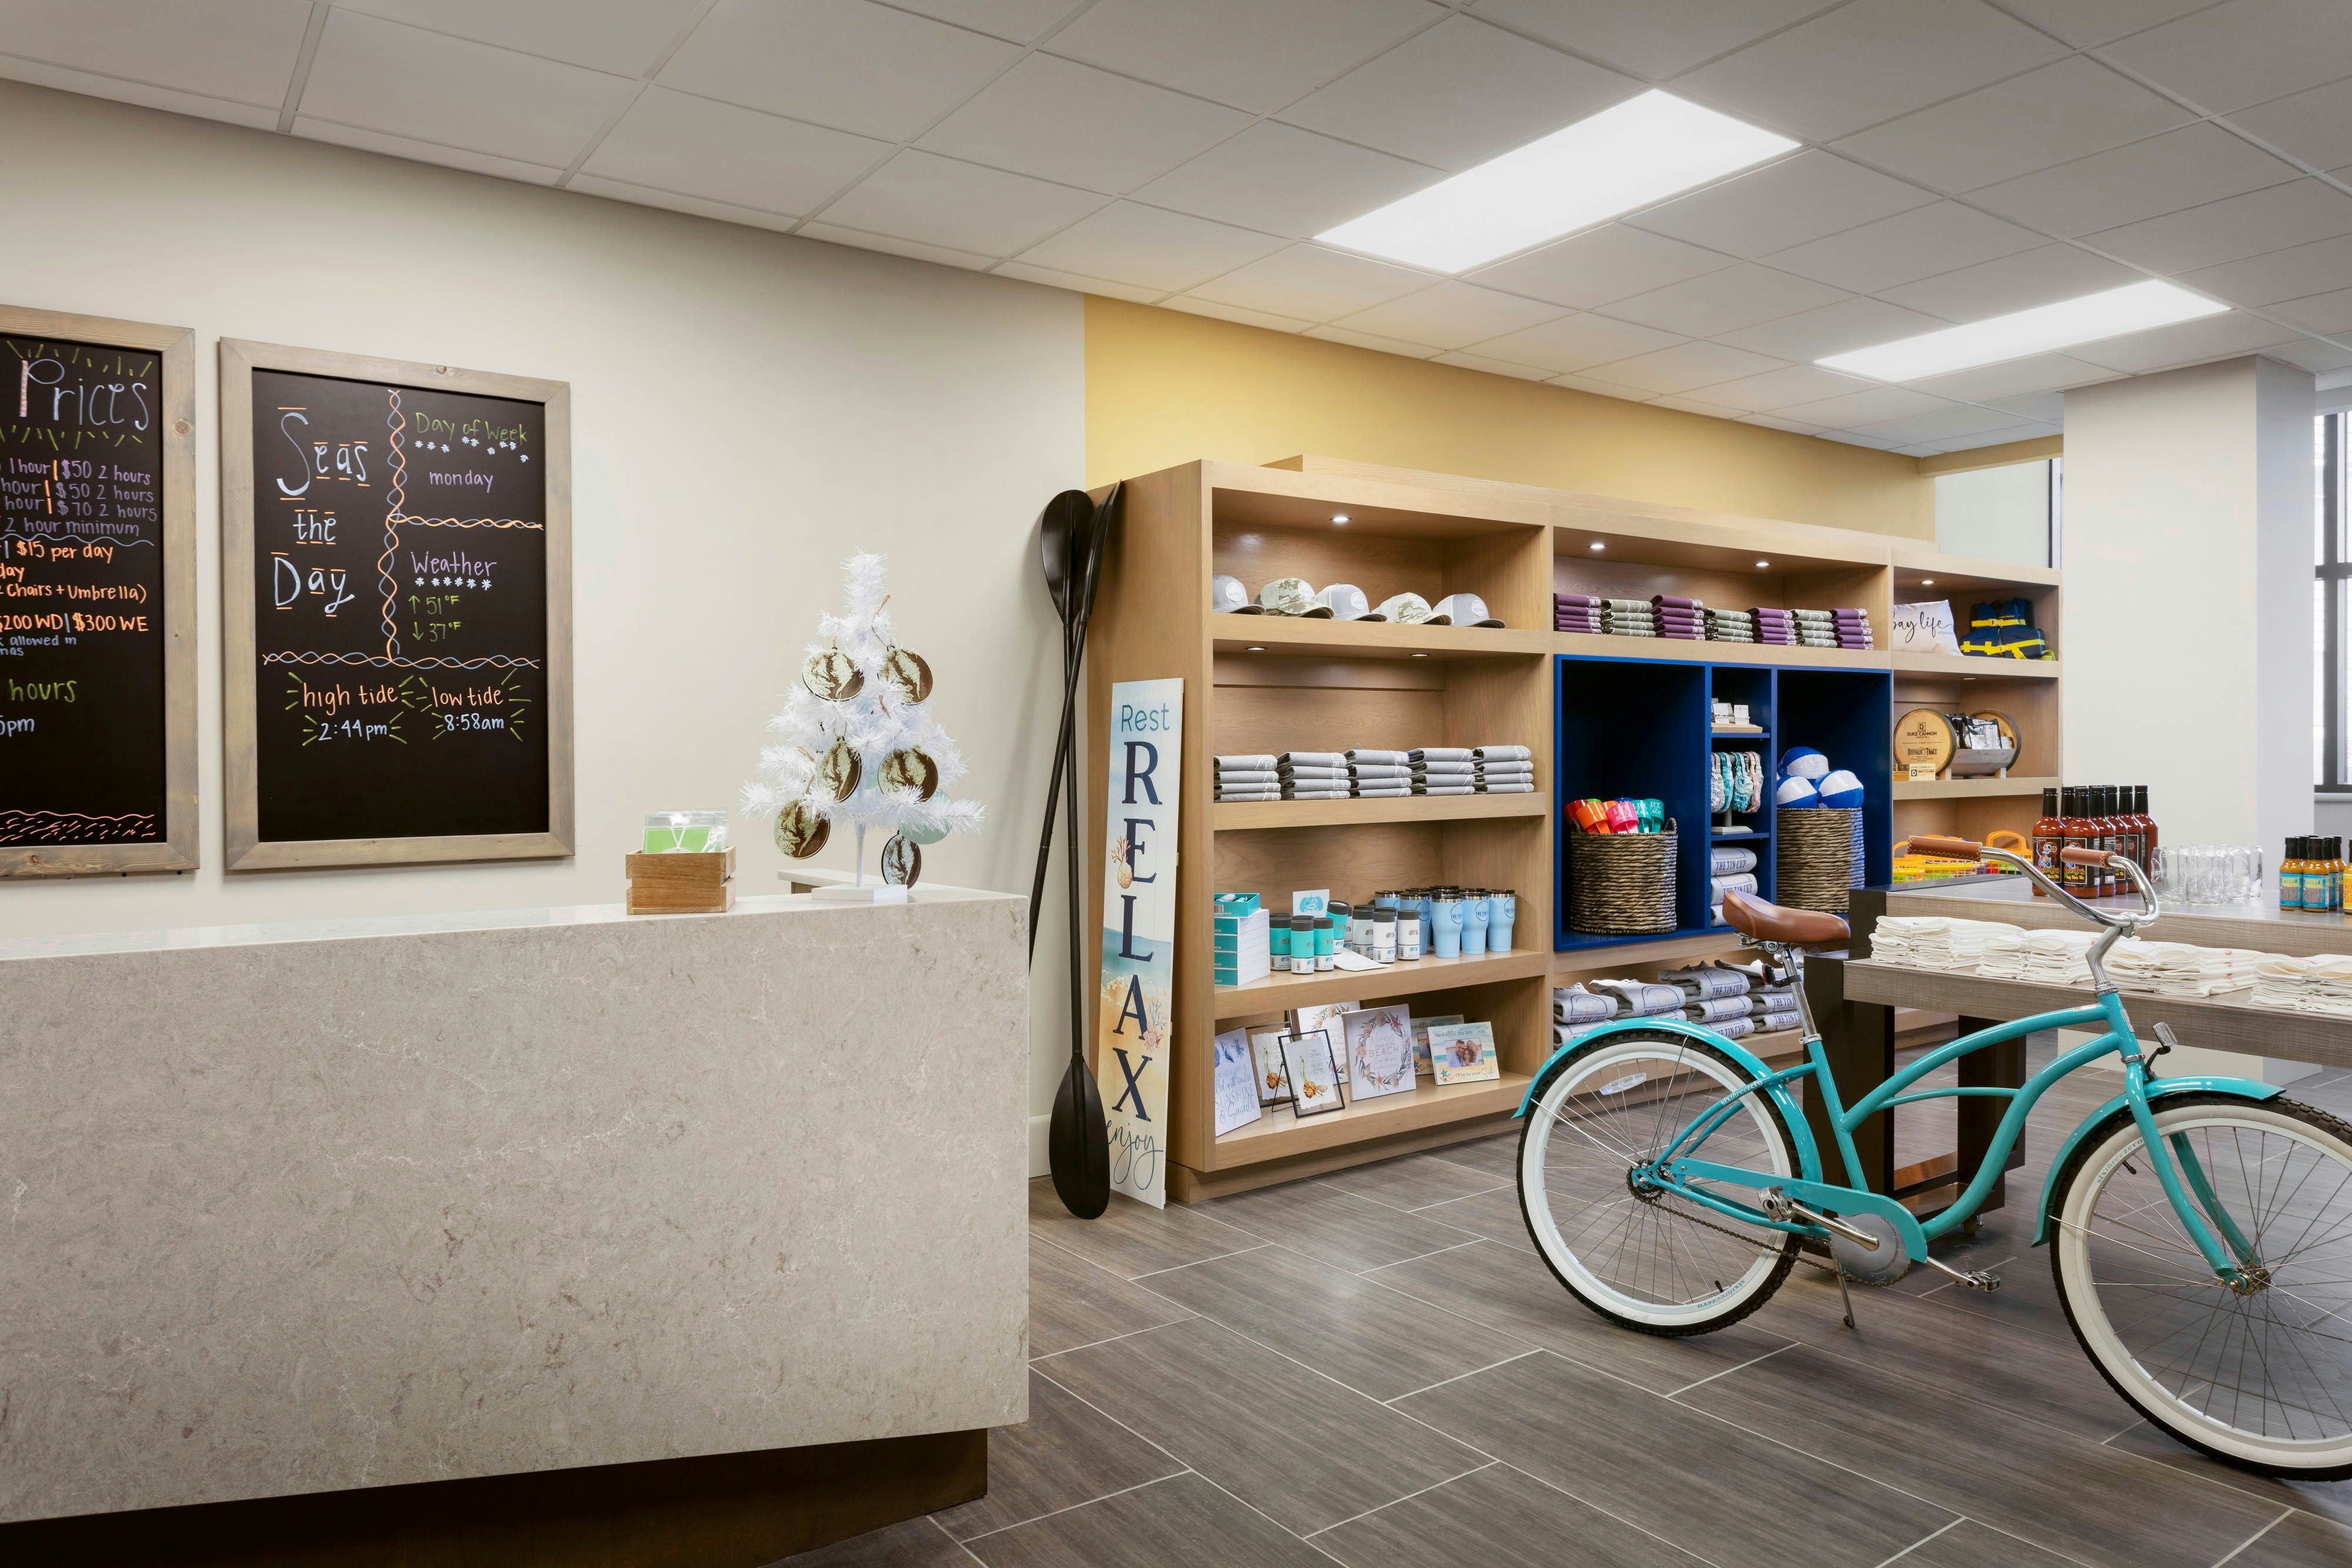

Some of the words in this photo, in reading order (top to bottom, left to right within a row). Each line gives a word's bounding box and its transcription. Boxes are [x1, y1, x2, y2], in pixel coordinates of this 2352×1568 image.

[20, 359, 149, 430] Prices
[415, 412, 455, 441] Day
[462, 420, 479, 439] of
[277, 413, 368, 496] Seas
[18, 459, 51, 474] hour
[62, 459, 92, 479] $50
[98, 466, 108, 479] 2
[114, 464, 151, 485] hours
[429, 470, 493, 493] monday
[0, 477, 41, 494] hour
[96, 484, 106, 500] 2
[113, 485, 154, 503] hours
[5, 495, 45, 510] hour
[99, 504, 109, 516] 2
[117, 504, 158, 521] hours
[5, 517, 16, 532] 2
[24, 517, 61, 533] hour
[66, 520, 139, 536] minimum
[293, 513, 336, 541] the
[16, 540, 45, 558] $15
[51, 547, 78, 562] per
[83, 543, 113, 564] day
[411, 551, 497, 576] Weather
[6, 583, 52, 597] Chairs
[274, 557, 355, 614] Day
[0, 615, 32, 632] 200
[35, 614, 64, 630] WD
[72, 613, 116, 631] $300
[119, 616, 149, 631] WE
[1920, 611, 1952, 637] life
[10, 635, 59, 646] allowed
[9, 679, 77, 703] hours
[303, 683, 350, 716] high
[359, 684, 398, 706] tide
[432, 687, 462, 707] low
[467, 686, 504, 706] tide
[1121, 703, 1170, 733] Rest
[1716, 861, 1726, 870] THE
[1727, 861, 1736, 870] TIN
[1736, 860, 1746, 869] CUP
[1743, 884, 1753, 893] CUP
[1112, 741, 1162, 1122] RELAX
[1712, 988, 1723, 996] THE
[1723, 987, 1732, 995] TIN
[1733, 985, 1743, 993] CUP
[1772, 998, 1783, 1007] THE
[1784, 997, 1792, 1006] TIN
[1725, 1027, 1734, 1037] TIN
[1735, 1025, 1745, 1035] CUP
[1775, 1015, 1785, 1024] THE
[1785, 1014, 1794, 1023] TIN
[1369, 1045, 1399, 1058] BEACH
[1721, 1081, 1763, 1106] sixthreezero
[2097, 1139, 2143, 1183] sixthreezero
[1698, 1279, 1745, 1308] sixthreezero
